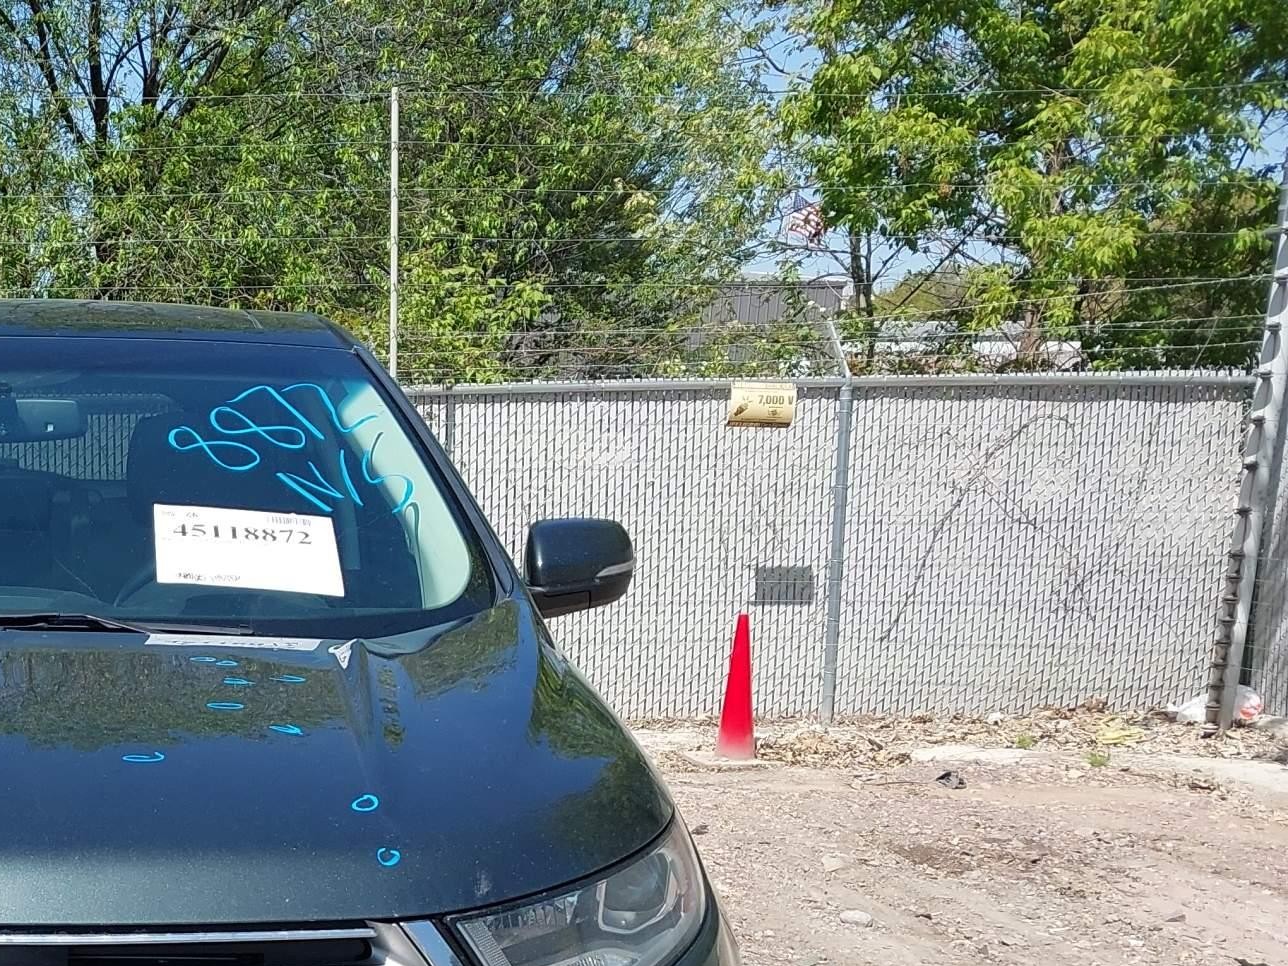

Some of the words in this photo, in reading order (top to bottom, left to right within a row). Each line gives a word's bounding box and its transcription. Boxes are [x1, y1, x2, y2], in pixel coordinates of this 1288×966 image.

[758, 395, 785, 406] 7,000
[168, 383, 378, 471] 8872
[172, 523, 313, 546] 45118872
